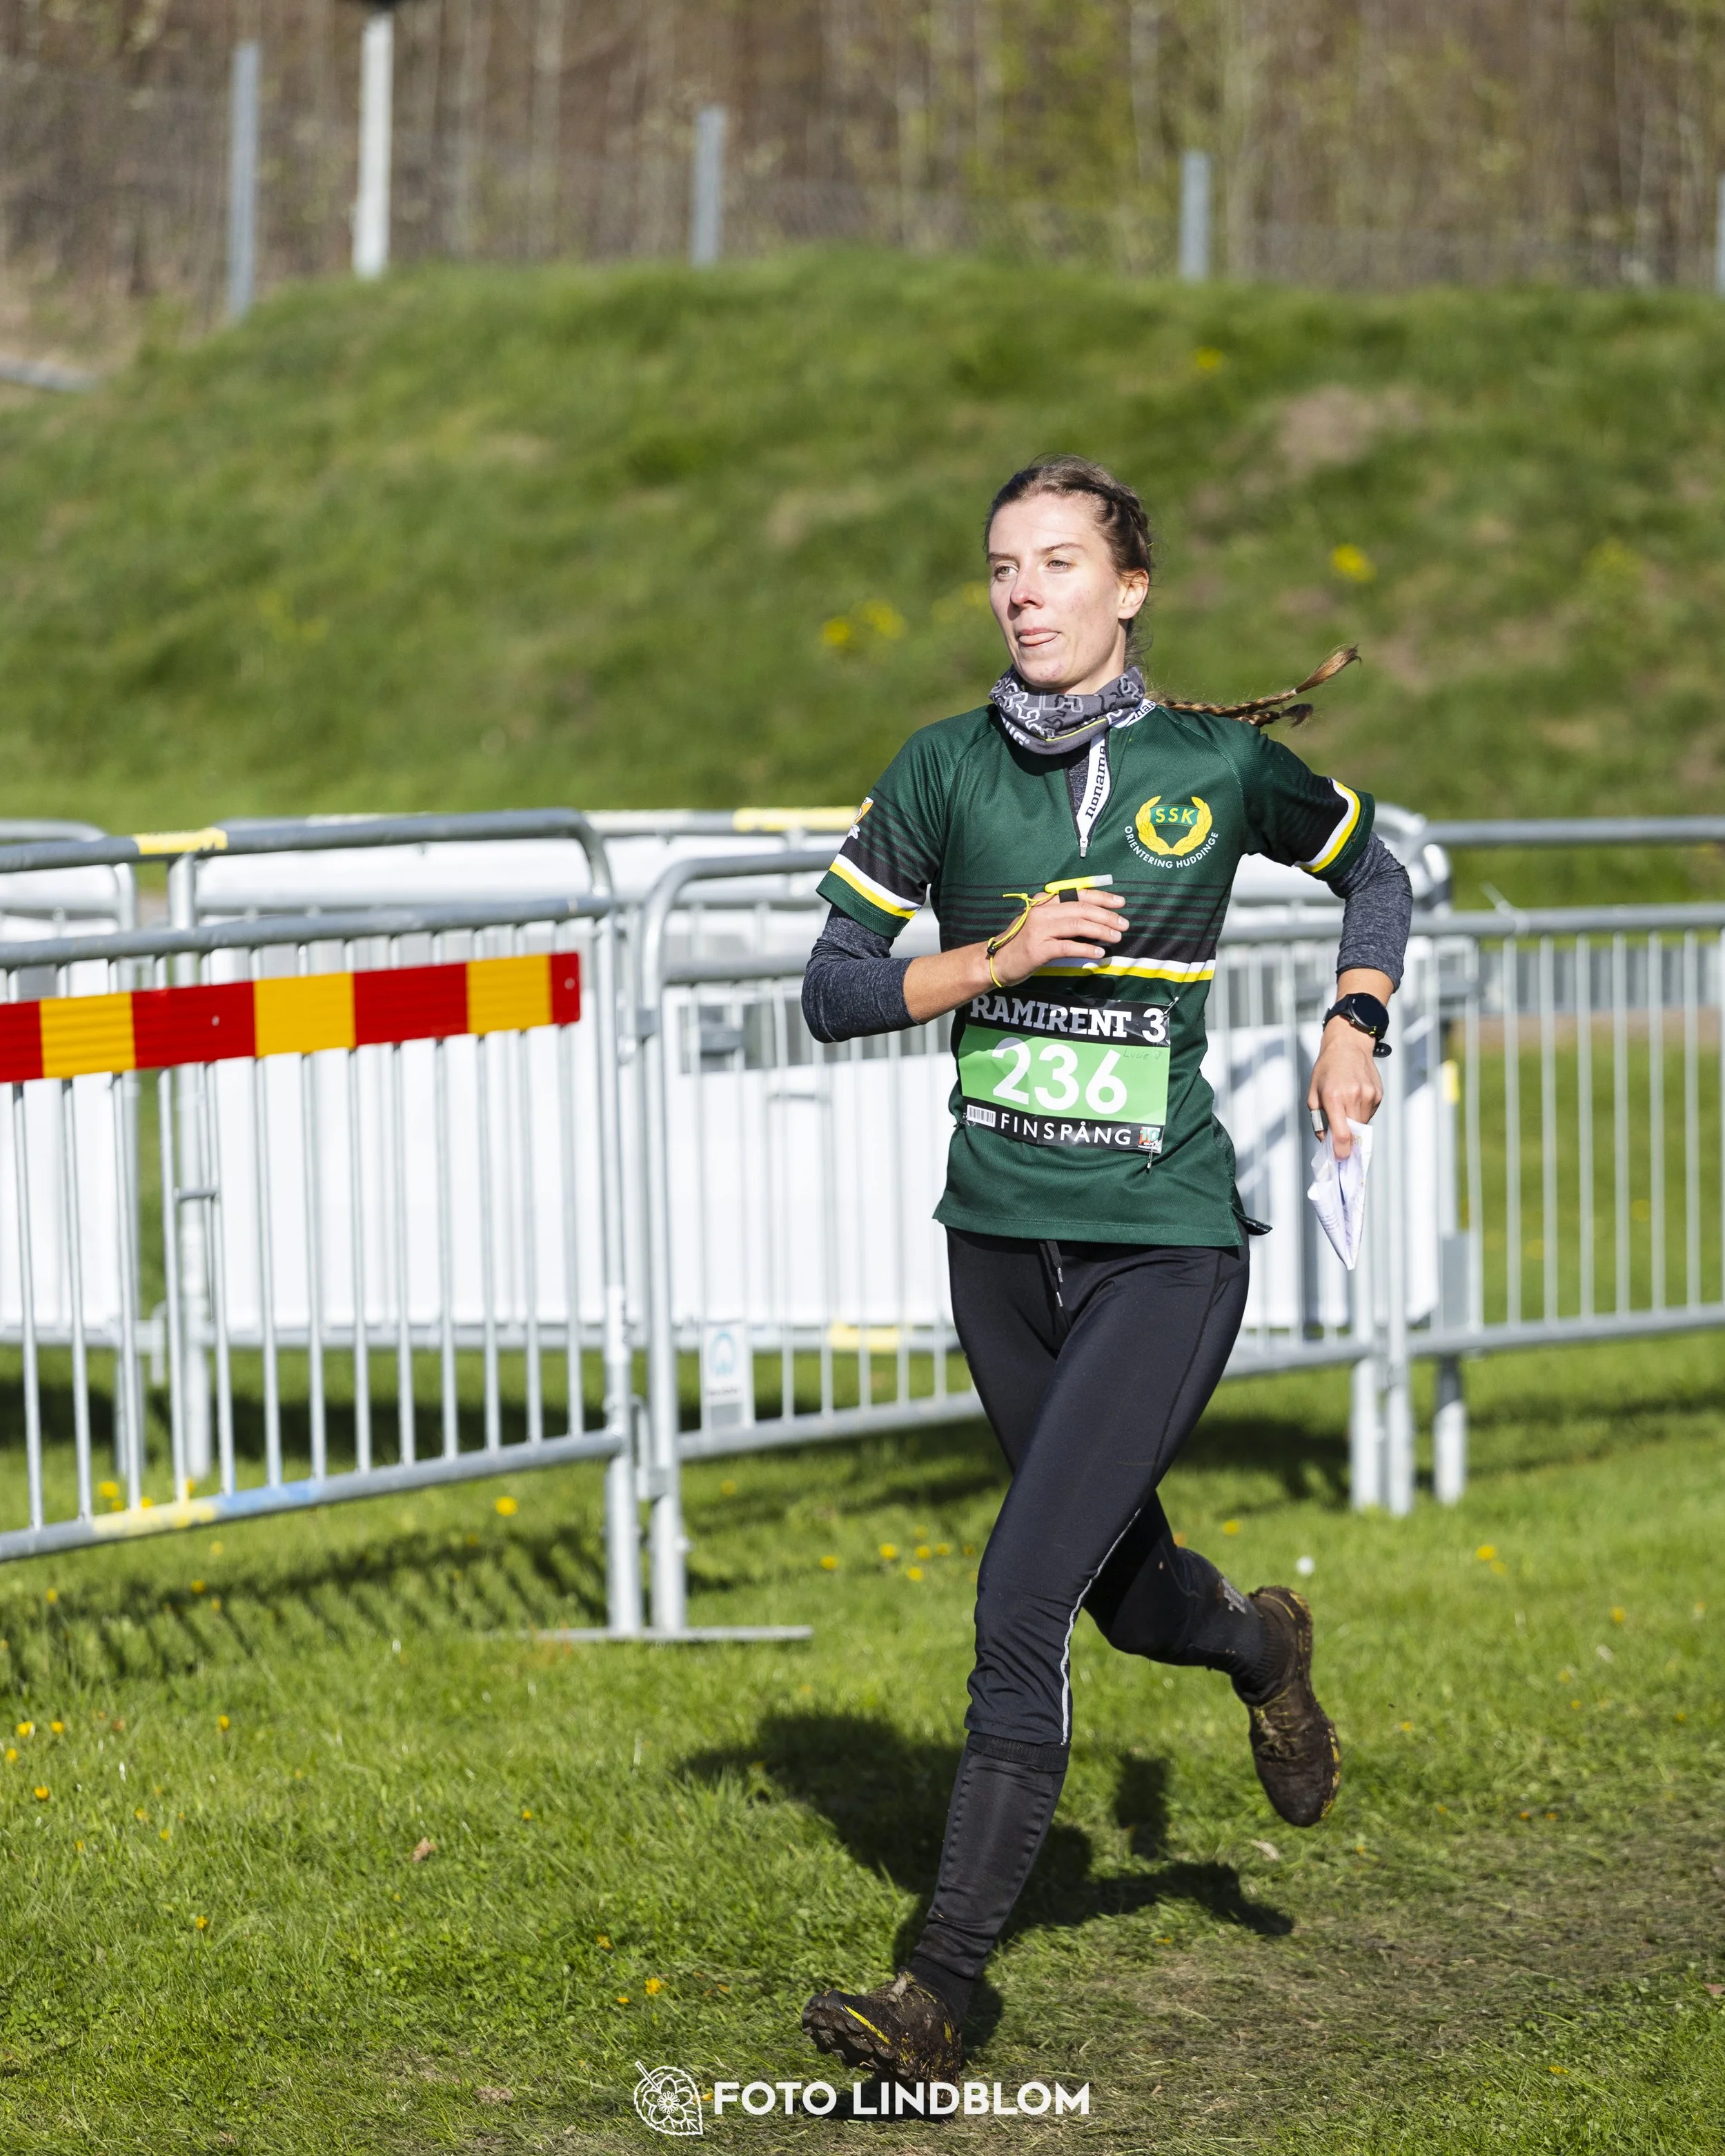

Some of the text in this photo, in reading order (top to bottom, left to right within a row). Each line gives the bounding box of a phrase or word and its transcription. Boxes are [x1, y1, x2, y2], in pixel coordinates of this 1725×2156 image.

[1155, 808, 1195, 824] SSK
[1124, 826, 1219, 869] ORIENTERING HUDDINGE
[970, 994, 1166, 1042] RAMIRENT 3
[992, 1037, 1127, 1114] 236
[1000, 1112, 1132, 1145] FINSPÅNG
